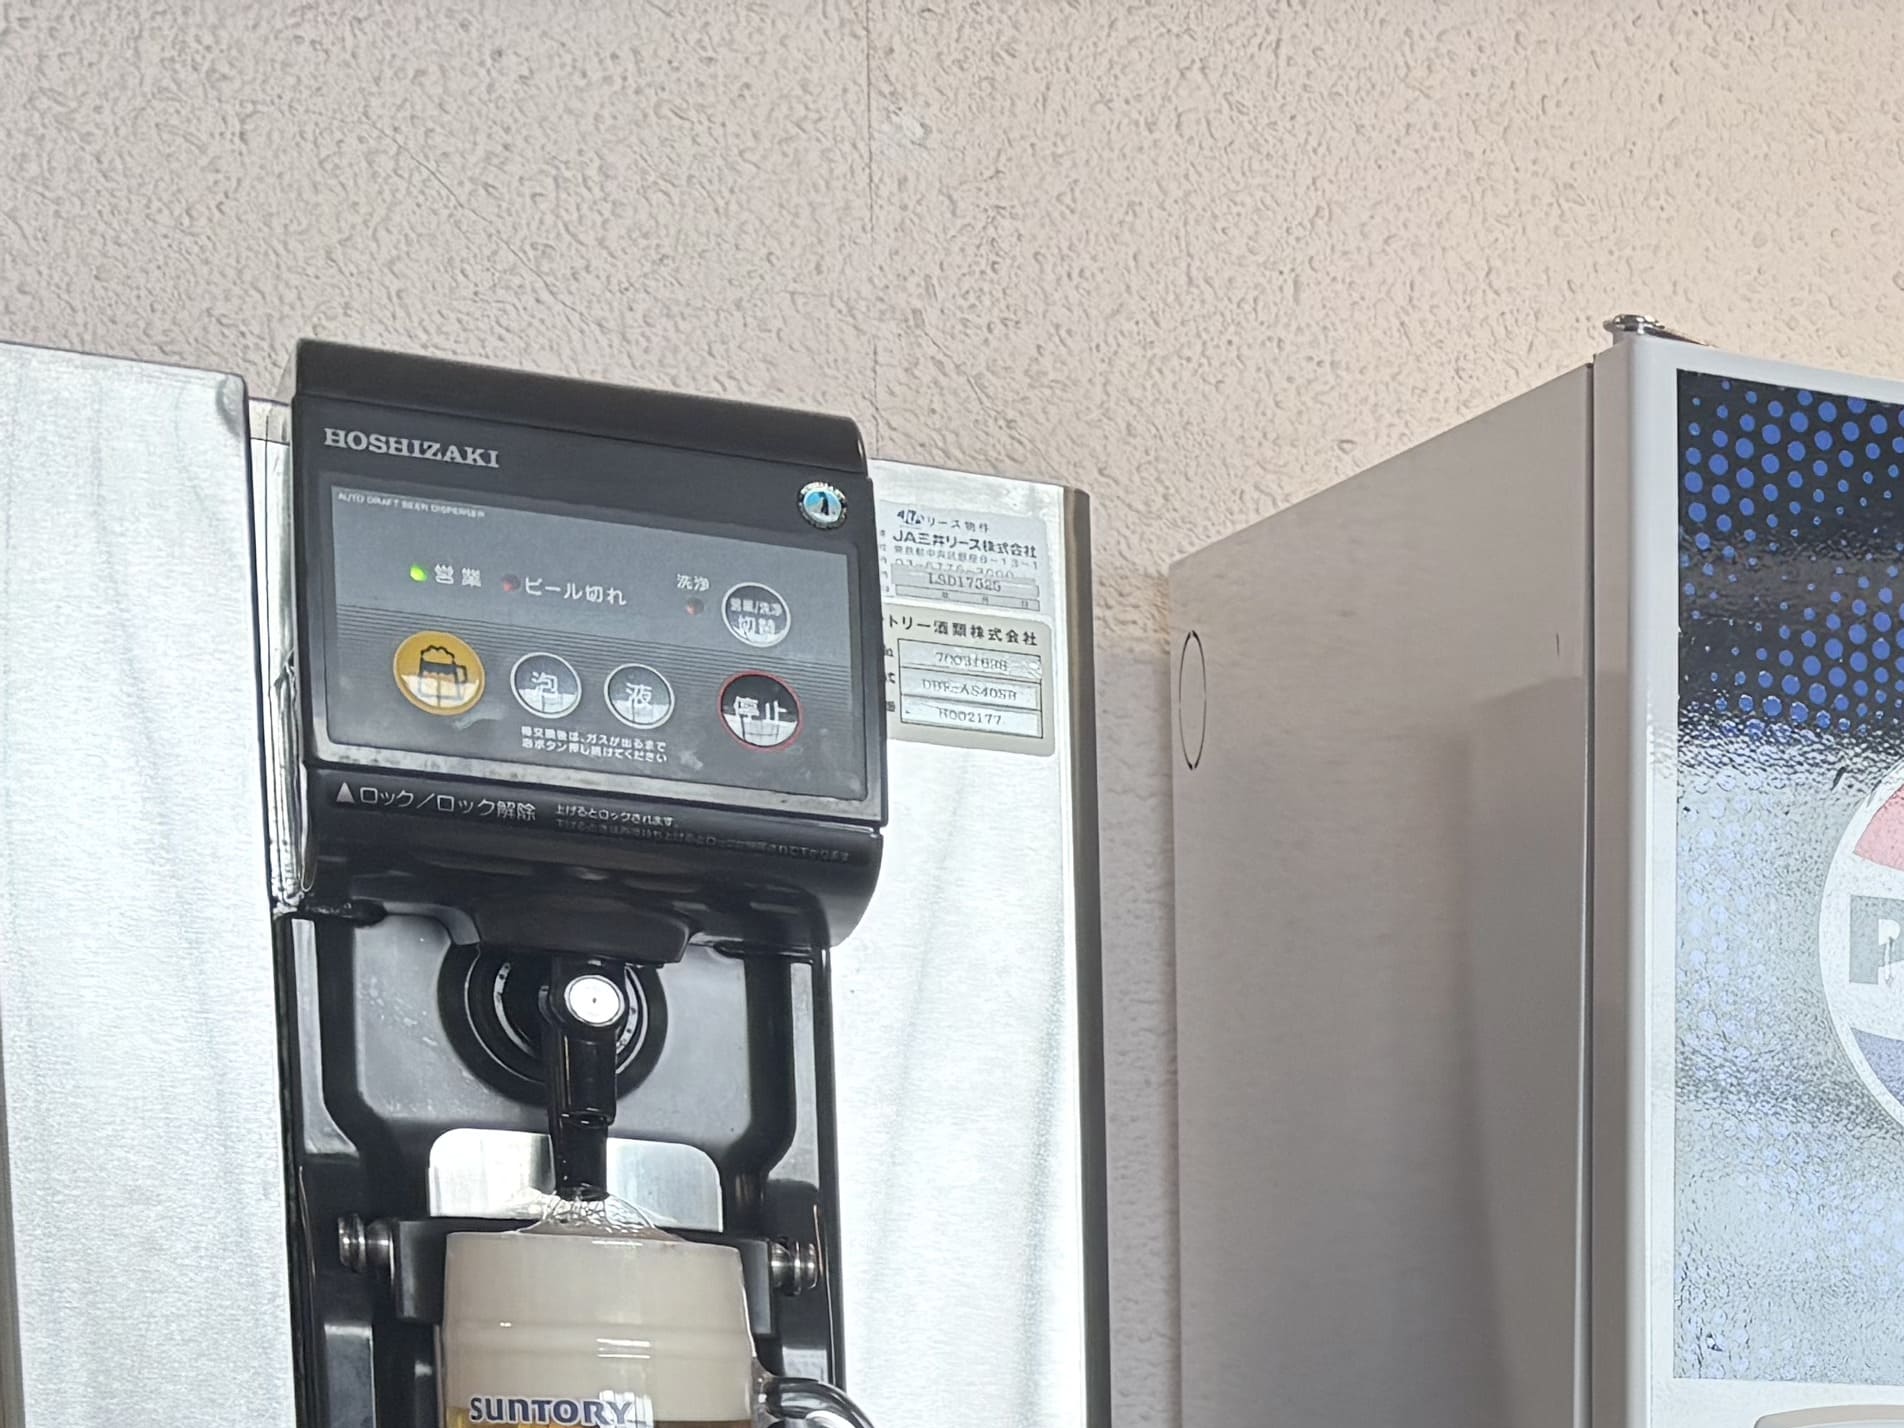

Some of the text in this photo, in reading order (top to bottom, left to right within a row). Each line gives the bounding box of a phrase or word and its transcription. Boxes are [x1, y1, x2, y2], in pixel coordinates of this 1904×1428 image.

[324, 427, 499, 468] HOSHIZAKI
[525, 577, 627, 607] ビール切れ
[676, 572, 711, 592] 洗浄
[625, 681, 653, 709] 液
[733, 695, 788, 724] 停止
[470, 1396, 633, 1426] SUNTORY
